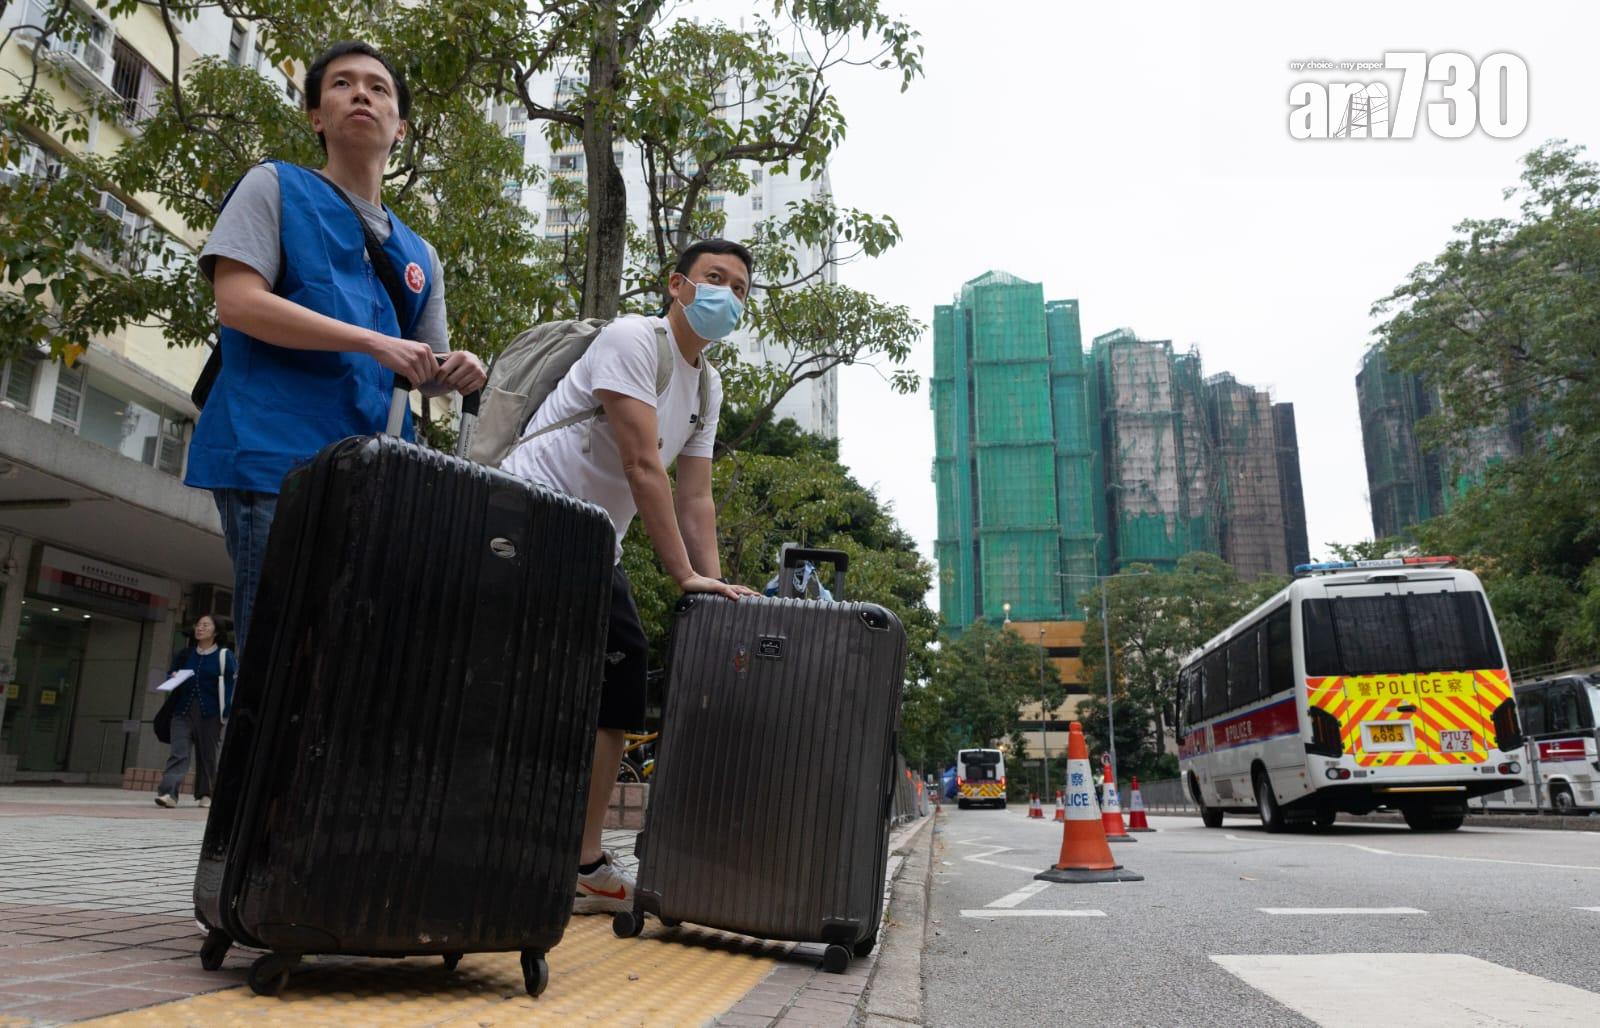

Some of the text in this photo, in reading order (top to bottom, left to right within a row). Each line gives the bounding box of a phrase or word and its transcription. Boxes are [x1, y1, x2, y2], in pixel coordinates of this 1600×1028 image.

[1358, 678, 1462, 697] 警 POLICE 察
